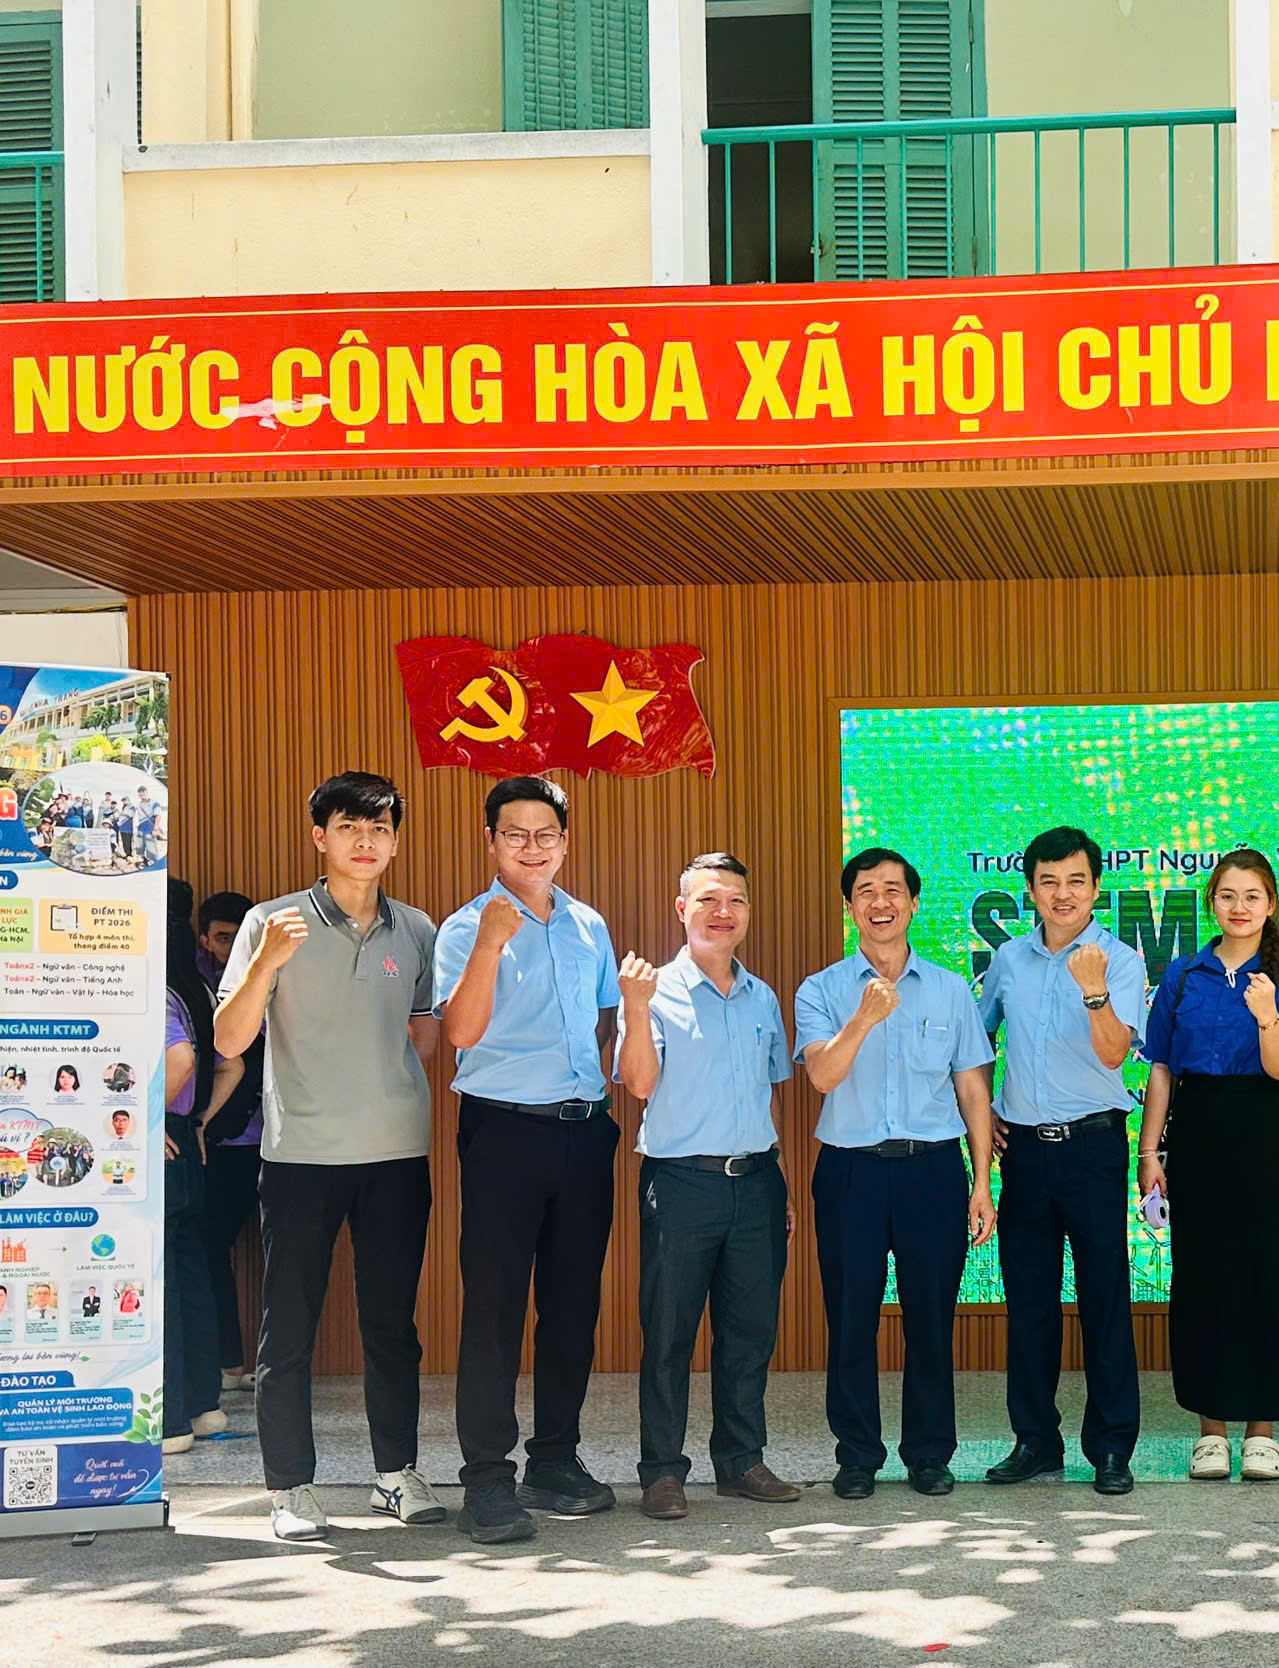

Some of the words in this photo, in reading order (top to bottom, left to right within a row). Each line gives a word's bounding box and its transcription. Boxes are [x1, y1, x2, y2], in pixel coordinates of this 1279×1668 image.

[15, 336, 240, 433] NƯỚC
[272, 330, 502, 443] CỘNG
[535, 322, 707, 421] HÒA
[736, 321, 853, 420] XÃ
[883, 315, 1023, 432] HỘI
[1058, 295, 1231, 409] CHỦ
[118, 908, 133, 916] THI
[107, 919, 131, 927] 2026
[82, 963, 104, 973] Công
[106, 976, 123, 984] Anh
[4, 987, 25, 995] Toán
[0, 1022, 50, 1035] NGÀNH
[53, 1024, 91, 1035] KTMT
[25, 1211, 51, 1225] VIỆC
[53, 1210, 63, 1223] Ở
[64, 1210, 94, 1223] ĐÂU?
[1, 1374, 29, 1387] ĐÀO
[31, 1375, 57, 1388] TẠO
[17, 1400, 44, 1408] QUẢN
[45, 1398, 55, 1406] LÝ
[57, 1397, 75, 1406] MÔI
[76, 1396, 113, 1404] TRƯỜNG
[26, 1405, 51, 1414] TOÀN
[64, 1404, 86, 1413] SINH
[87, 1403, 104, 1411] LAO
[106, 1402, 132, 1412] ĐỘNG
